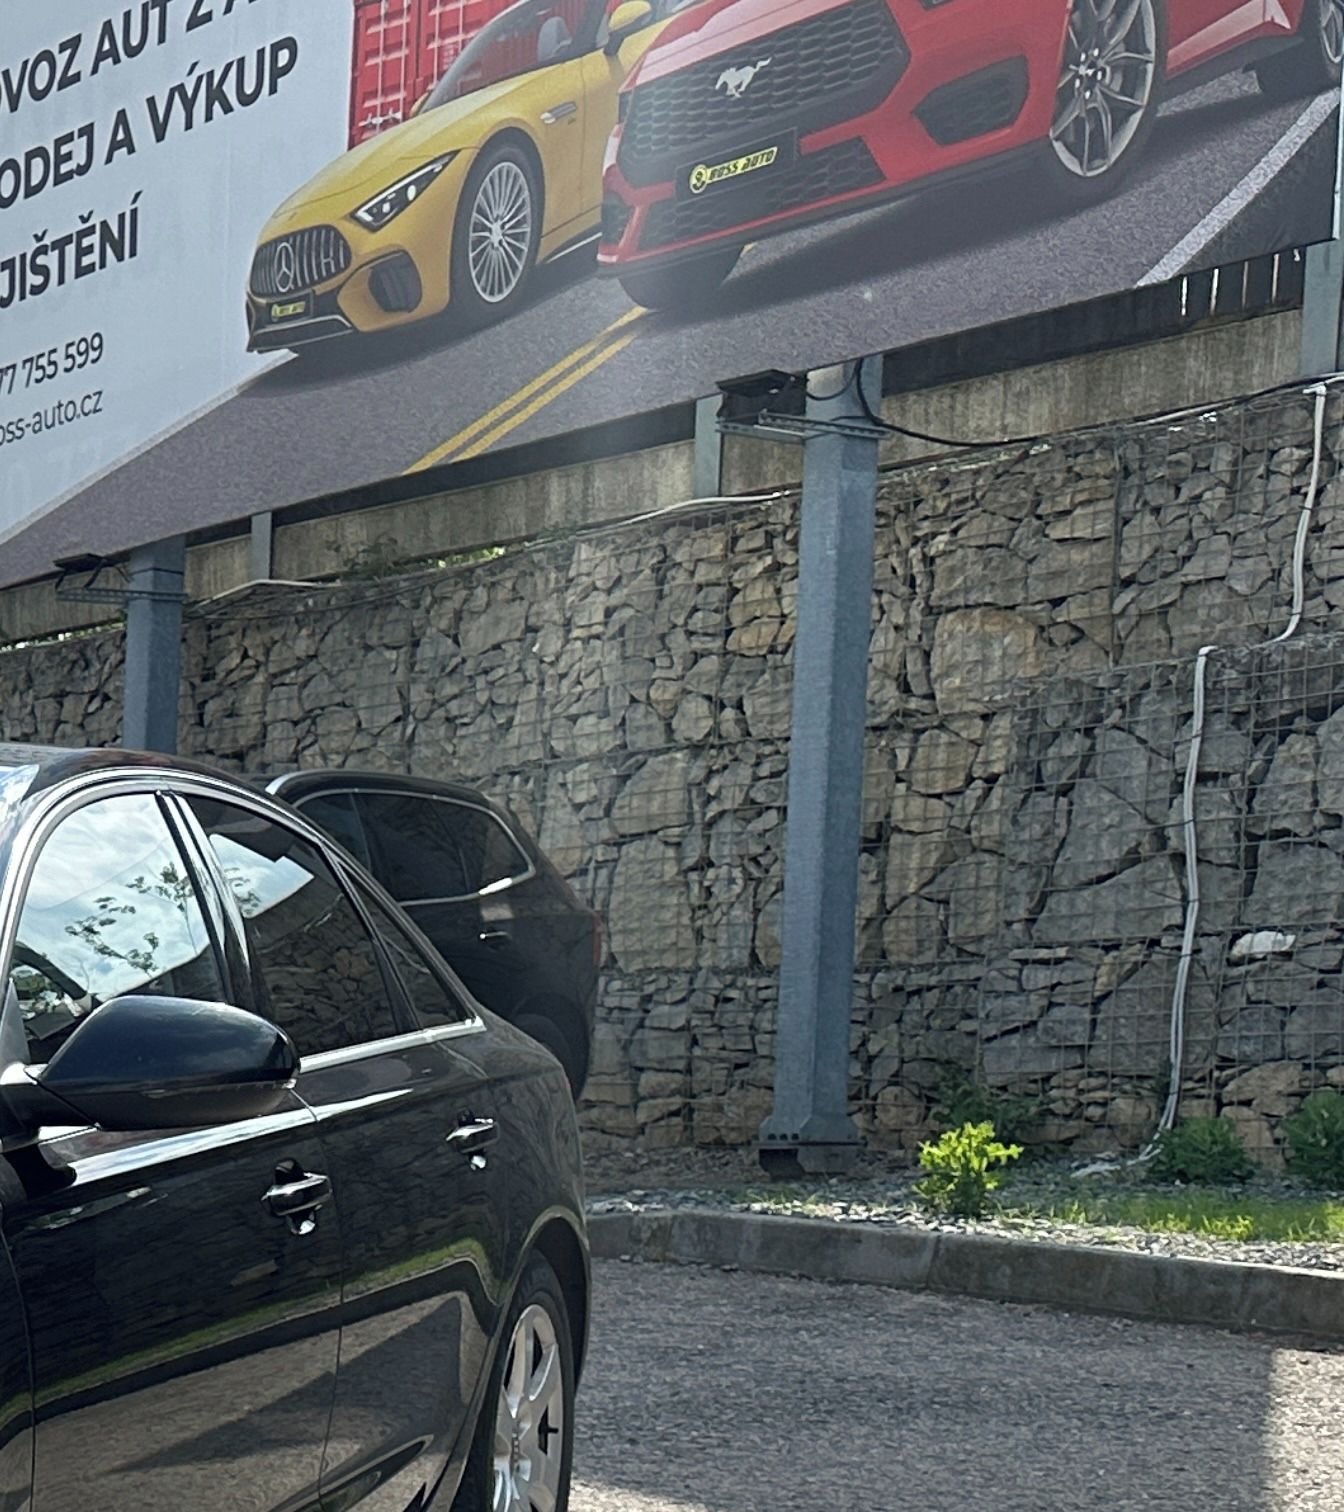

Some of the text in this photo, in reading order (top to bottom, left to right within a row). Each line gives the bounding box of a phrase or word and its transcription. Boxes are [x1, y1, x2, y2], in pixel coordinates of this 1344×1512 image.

[90, 0, 168, 76] AUT
[104, 107, 136, 165] A
[145, 36, 299, 143] VÝKUP
[22, 348, 58, 388] 755
[63, 332, 104, 373] 599
